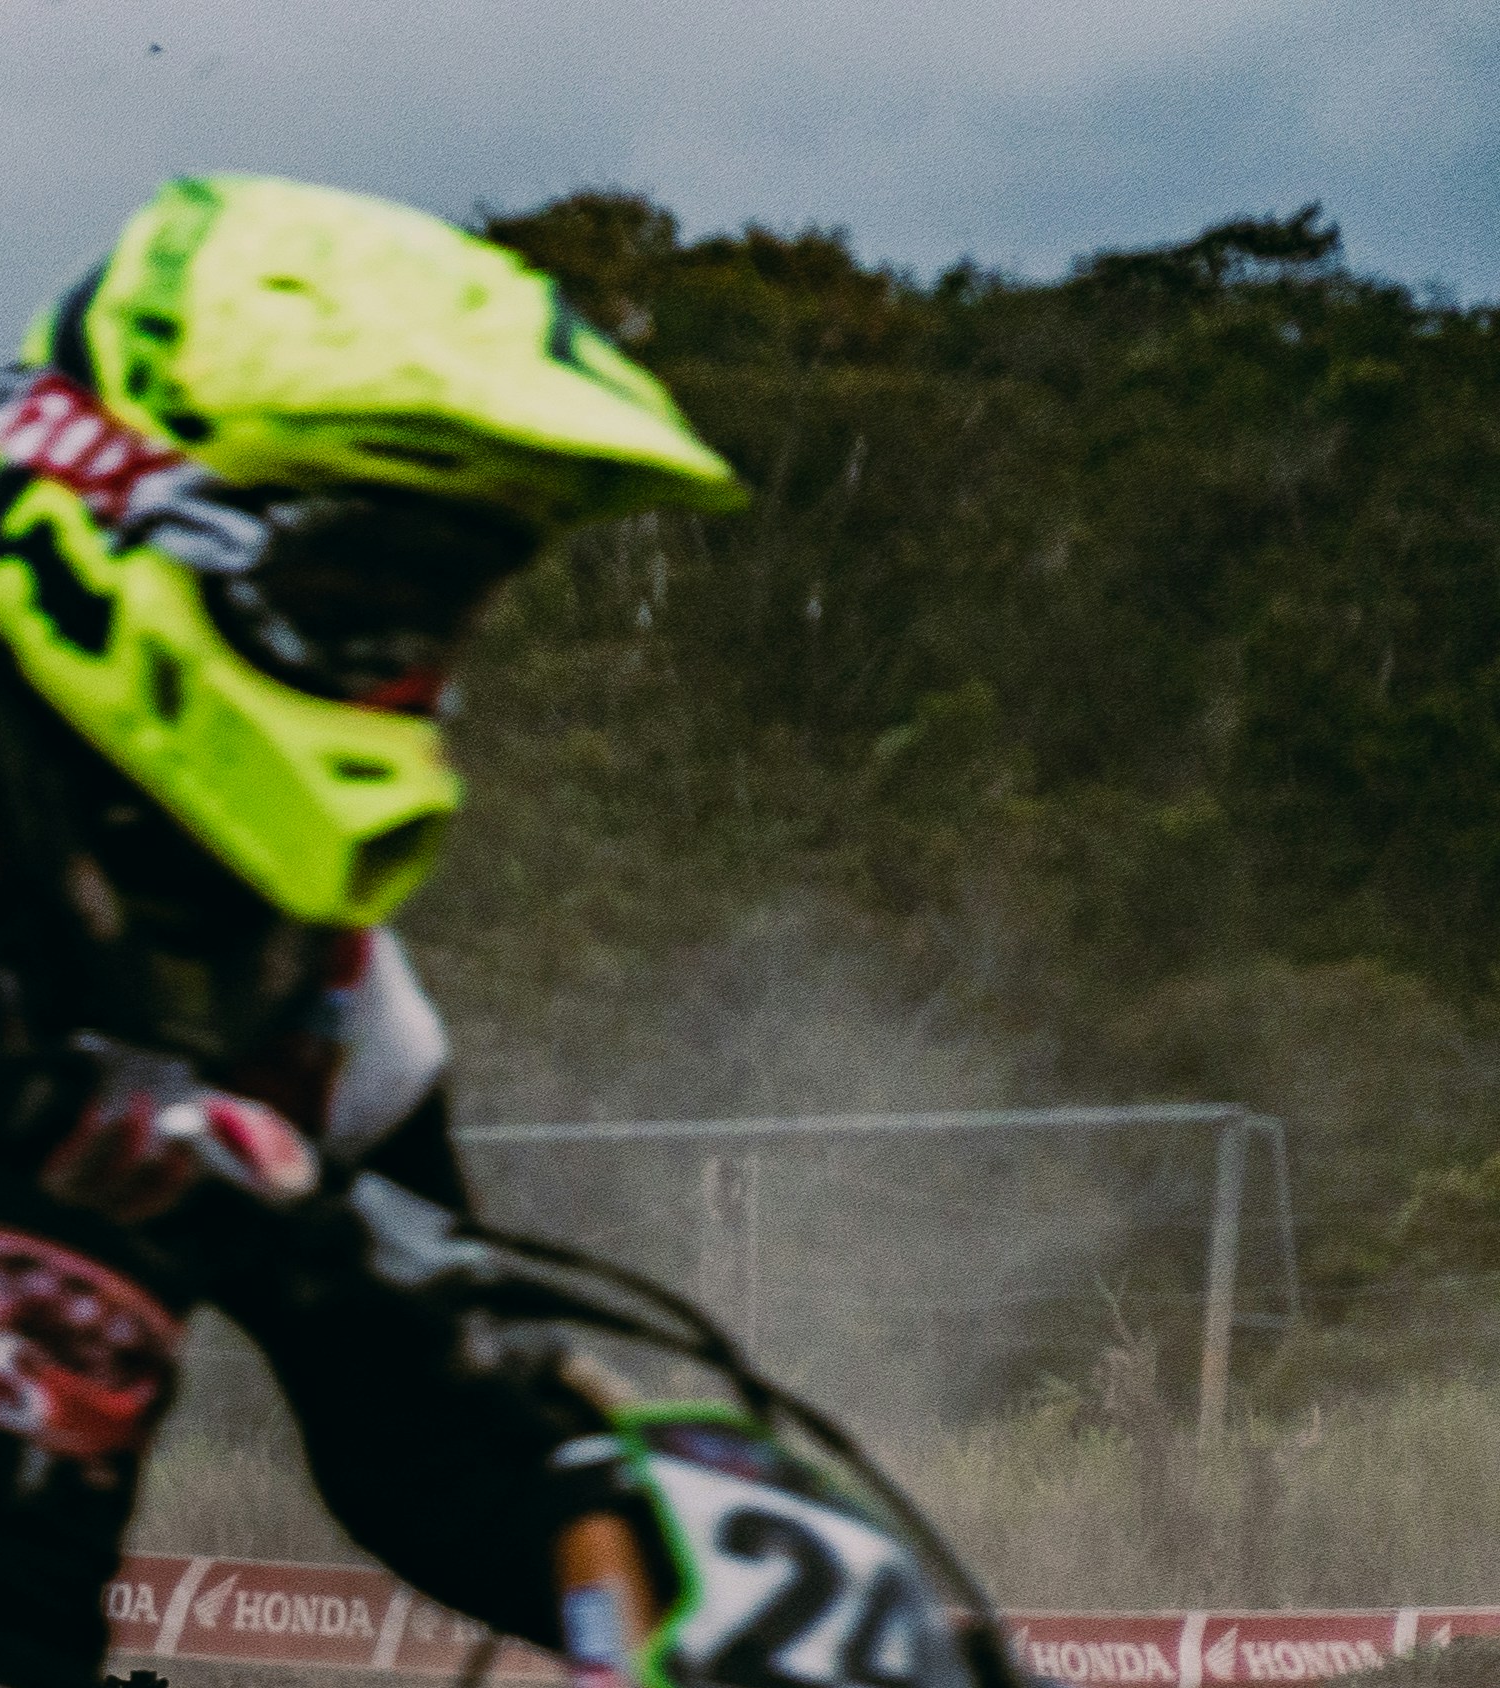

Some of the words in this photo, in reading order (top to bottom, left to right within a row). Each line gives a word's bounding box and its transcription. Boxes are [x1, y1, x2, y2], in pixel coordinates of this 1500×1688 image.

[233, 1590, 378, 1638] HONDA
[1029, 1641, 1179, 1682] HONDA
[1241, 1640, 1390, 1682] HONDA
